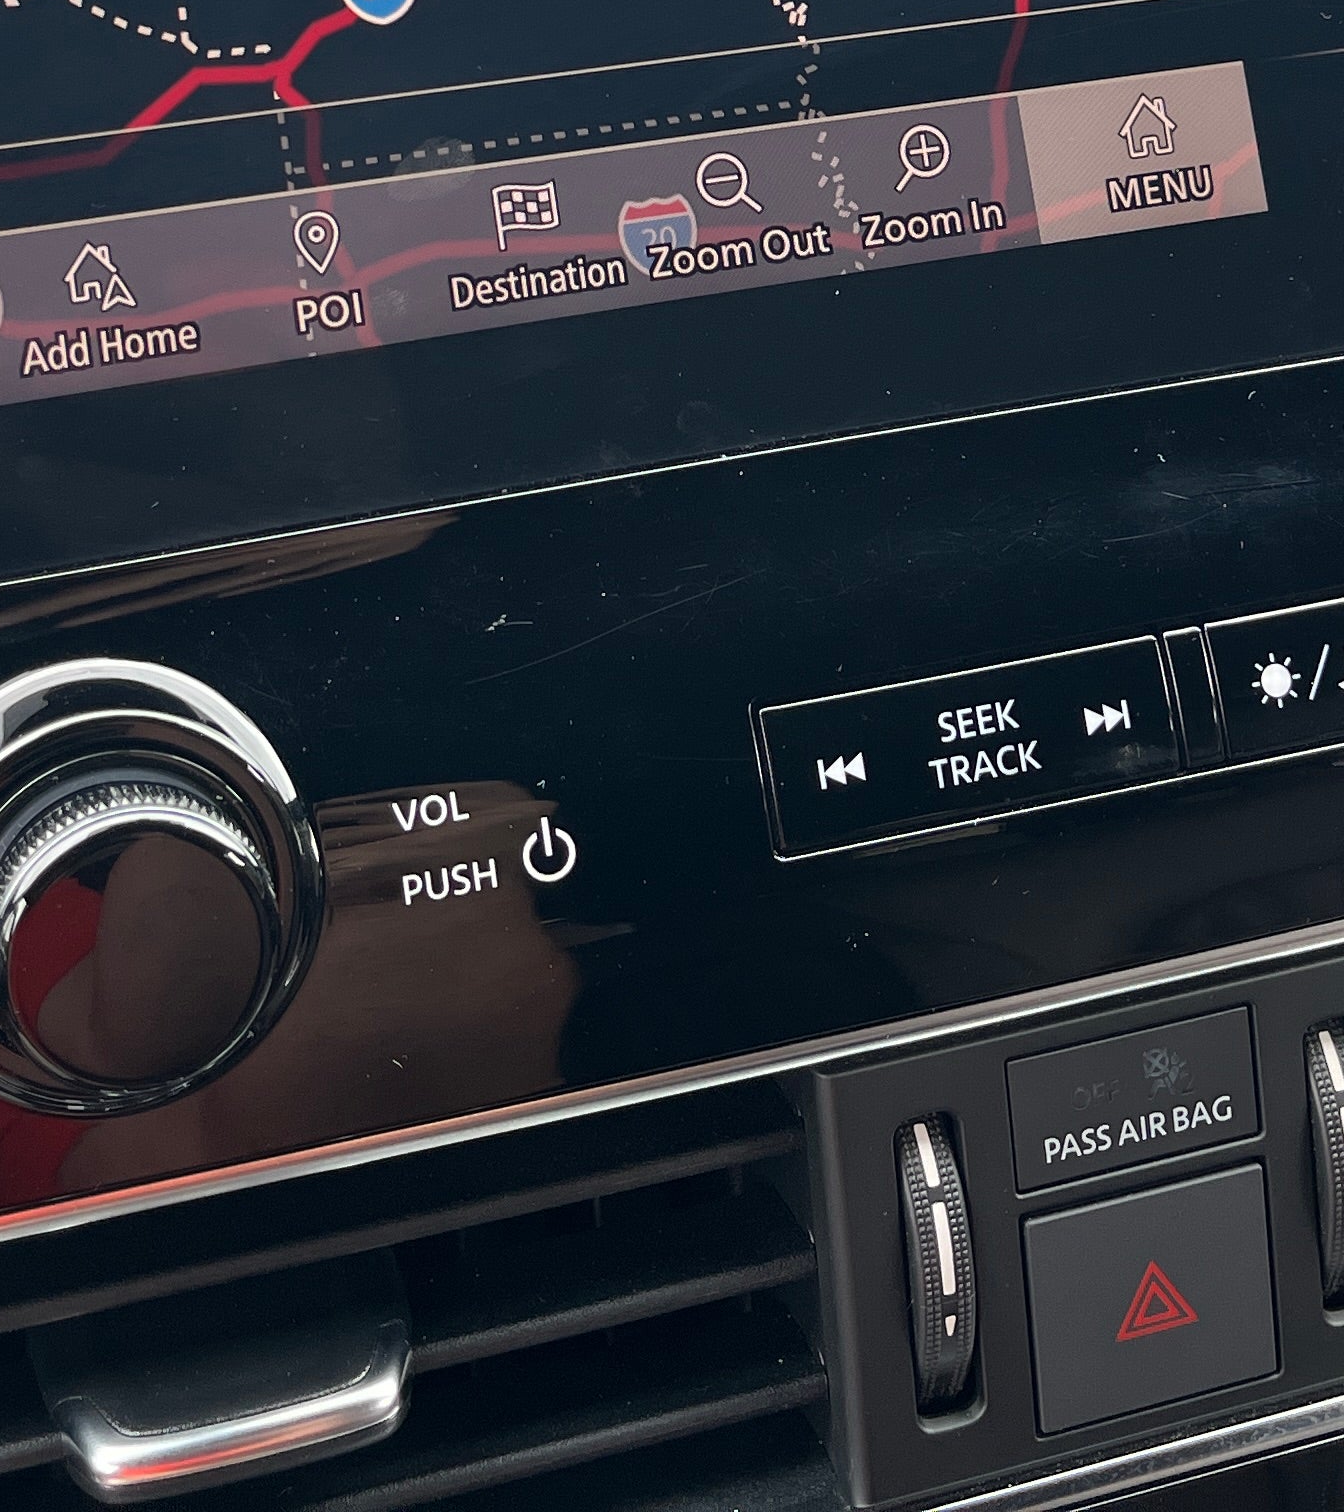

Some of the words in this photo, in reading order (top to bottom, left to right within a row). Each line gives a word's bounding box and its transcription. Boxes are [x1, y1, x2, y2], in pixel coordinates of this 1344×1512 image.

[1107, 166, 1214, 212] MENU
[862, 209, 963, 250] Zoom
[970, 199, 1005, 235] In
[649, 236, 755, 281] Zoom
[763, 223, 831, 267] Out
[450, 253, 627, 311] Destination
[294, 292, 364, 334] POI
[22, 332, 92, 377] Add
[99, 320, 201, 367] Home
[936, 698, 1020, 744] SEEK
[927, 740, 1044, 789] TRACK
[391, 791, 470, 832] VOL
[401, 857, 499, 906] PUSH
[1043, 1122, 1113, 1164] PASS
[1118, 1112, 1169, 1148] AIR
[1172, 1094, 1234, 1134] BAG
